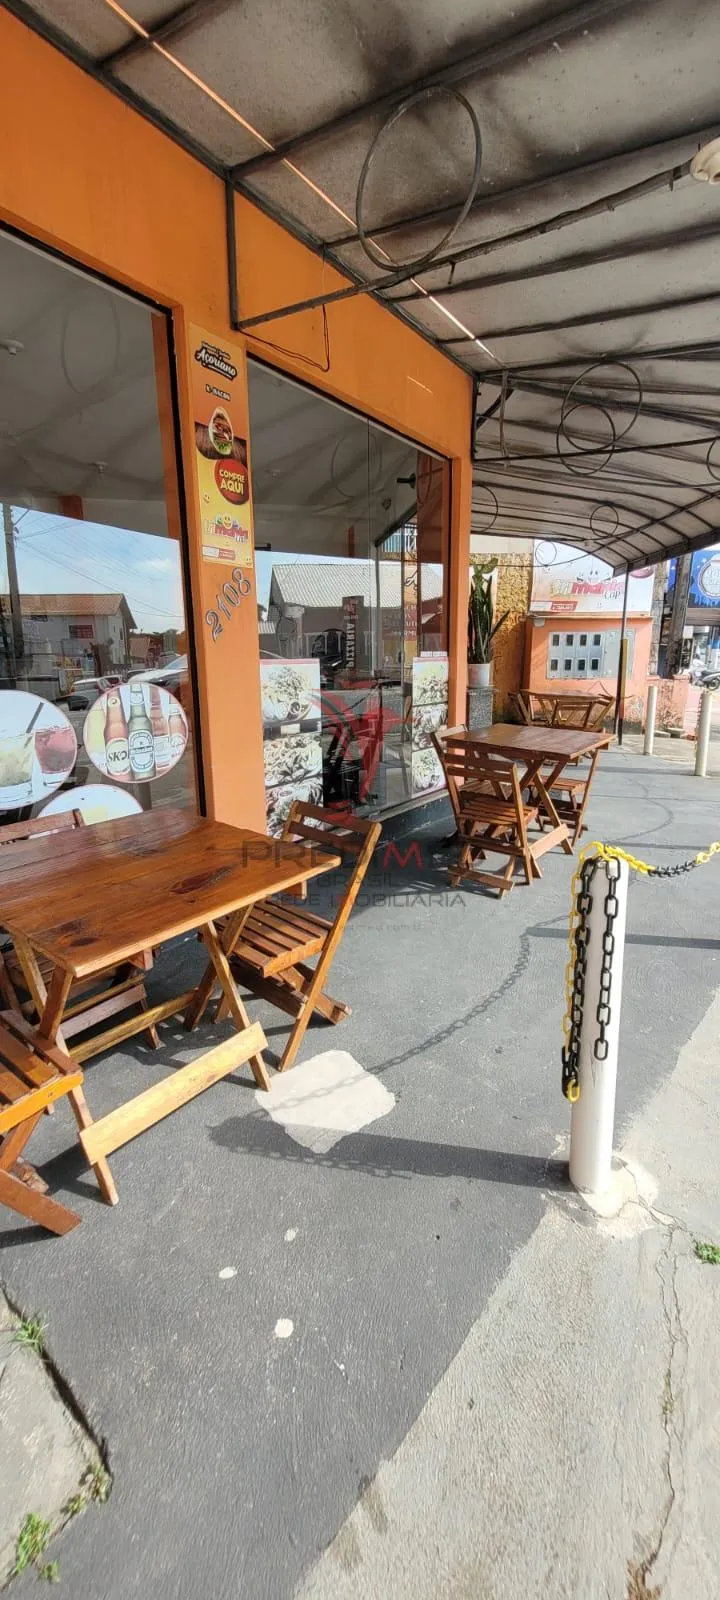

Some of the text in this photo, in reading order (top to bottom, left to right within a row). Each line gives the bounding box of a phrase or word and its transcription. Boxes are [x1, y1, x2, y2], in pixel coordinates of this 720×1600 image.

[197, 348, 236, 376] Açoriano
[219, 469, 245, 483] COMPRE
[220, 478, 244, 494] AQUI
[206, 567, 251, 643] 2108
